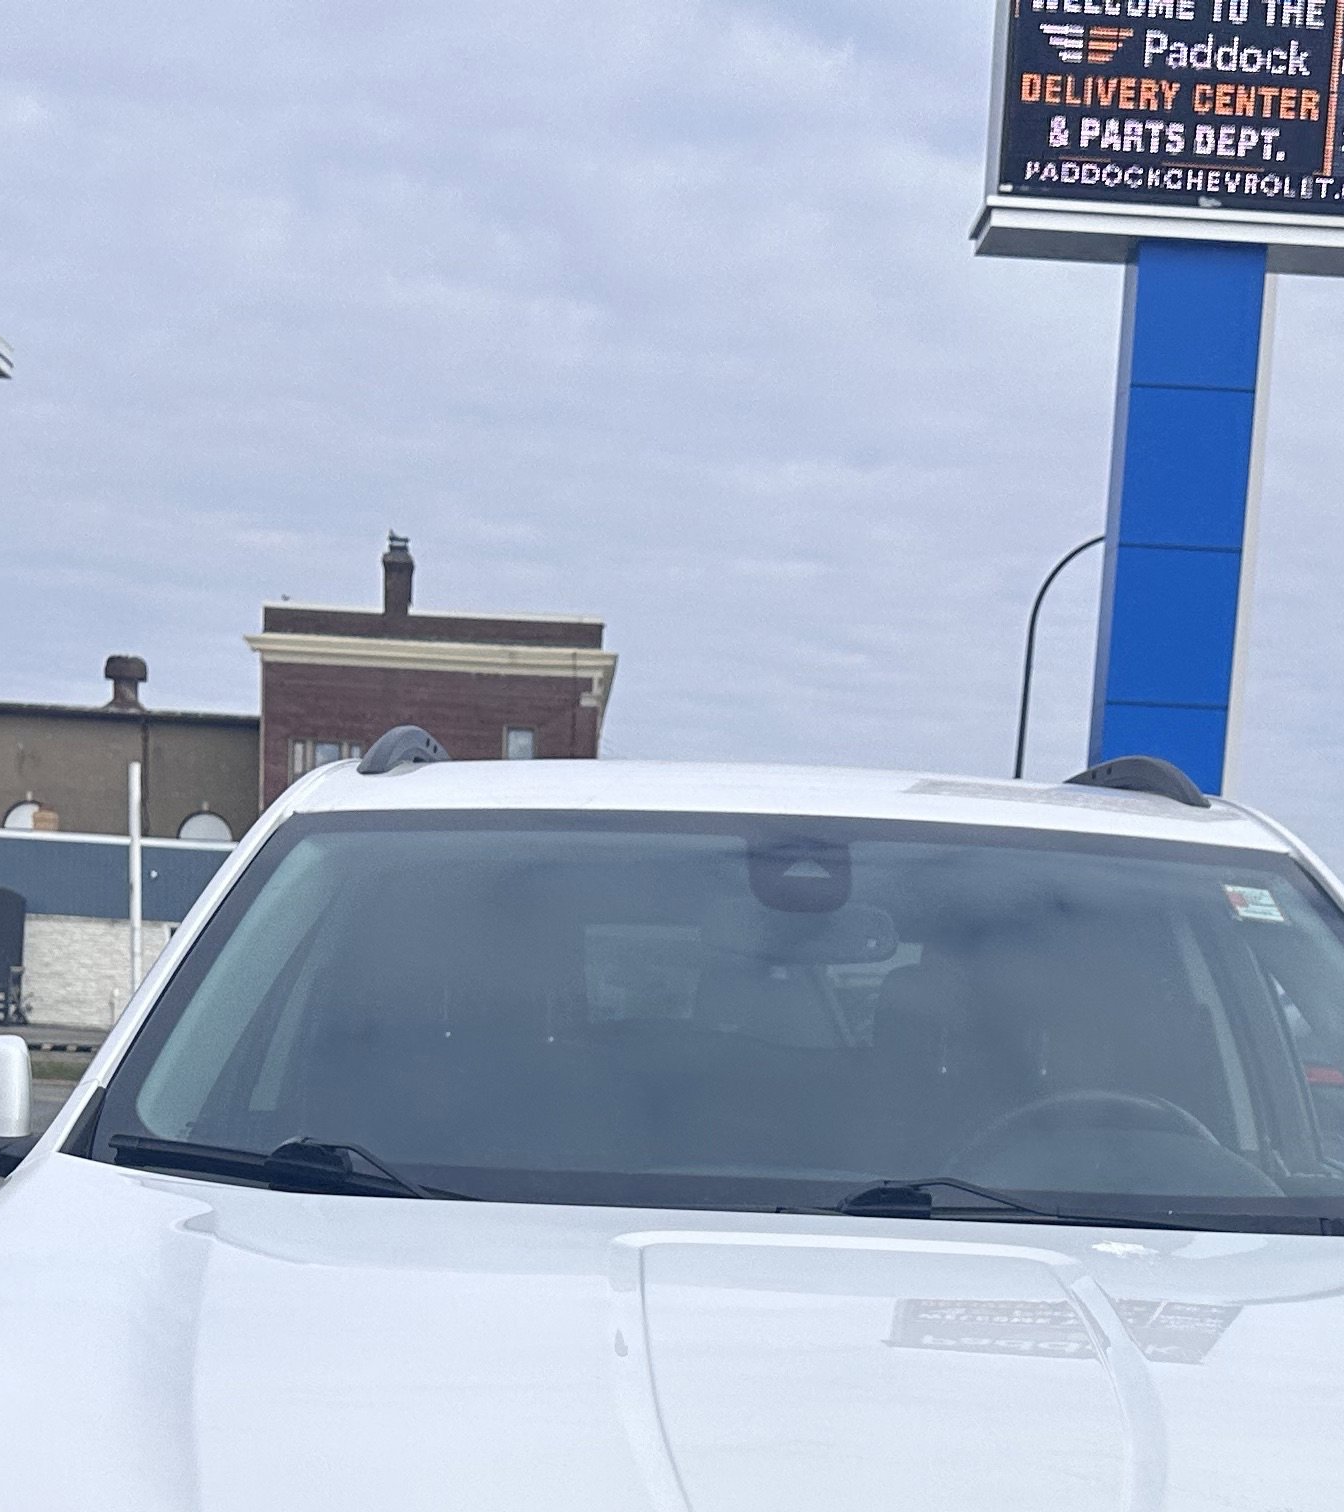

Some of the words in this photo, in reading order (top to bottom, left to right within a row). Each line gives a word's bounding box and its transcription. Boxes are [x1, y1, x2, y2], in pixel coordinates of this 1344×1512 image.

[1212, 0, 1249, 25] TO
[1264, 0, 1326, 30] THE
[1143, 29, 1311, 76] Paddock
[1020, 72, 1181, 112] DELIVERY
[1192, 83, 1320, 121] CENTER
[1048, 114, 1070, 149] &
[1079, 116, 1186, 154] PARTS
[1193, 123, 1286, 162] DEPT.
